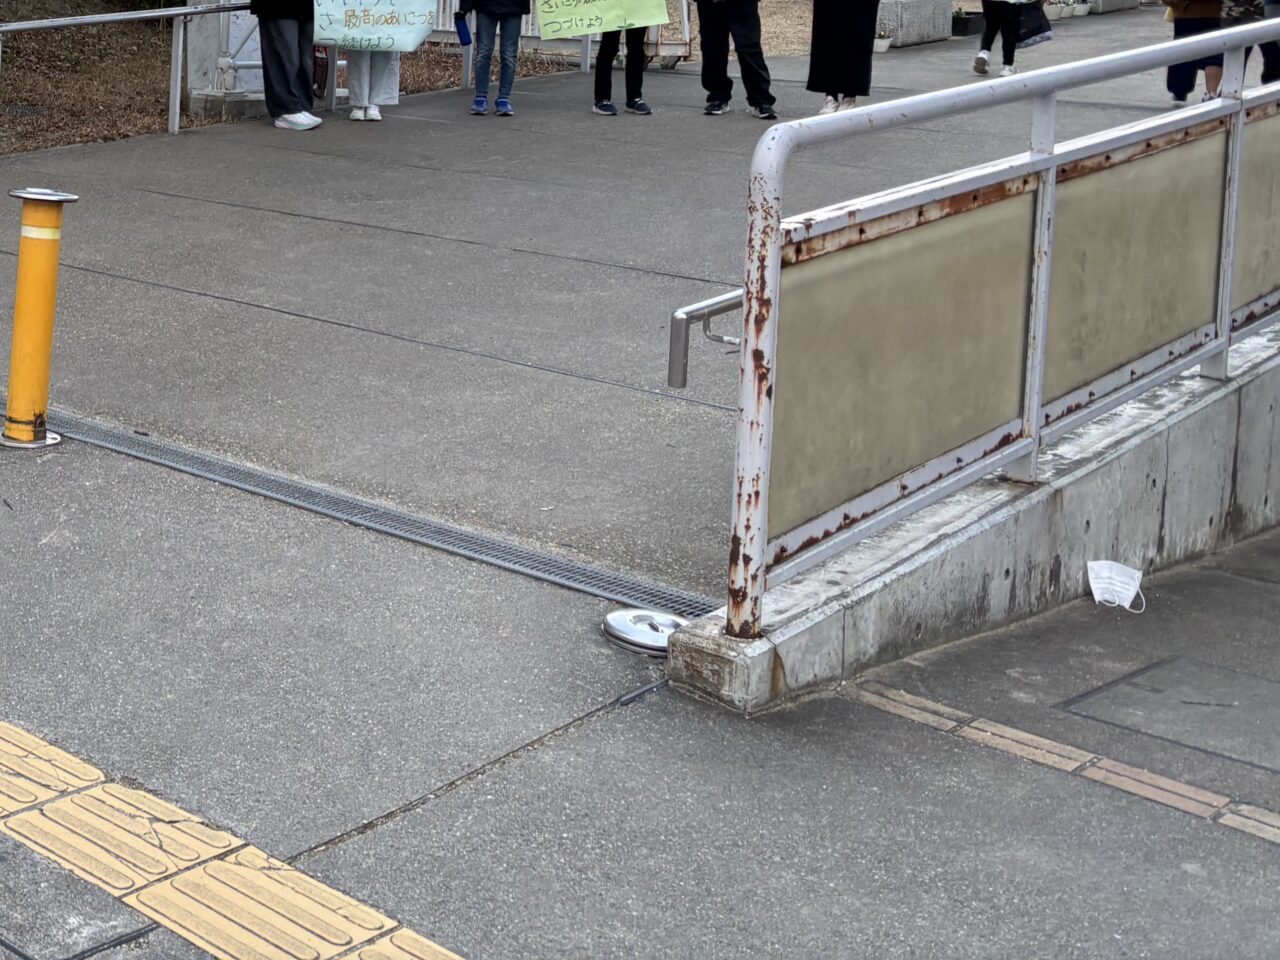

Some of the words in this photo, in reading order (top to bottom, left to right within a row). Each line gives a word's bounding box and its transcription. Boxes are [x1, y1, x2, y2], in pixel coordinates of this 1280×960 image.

[319, 11, 335, 31] さ
[344, 8, 434, 30] 最高のあいさつを
